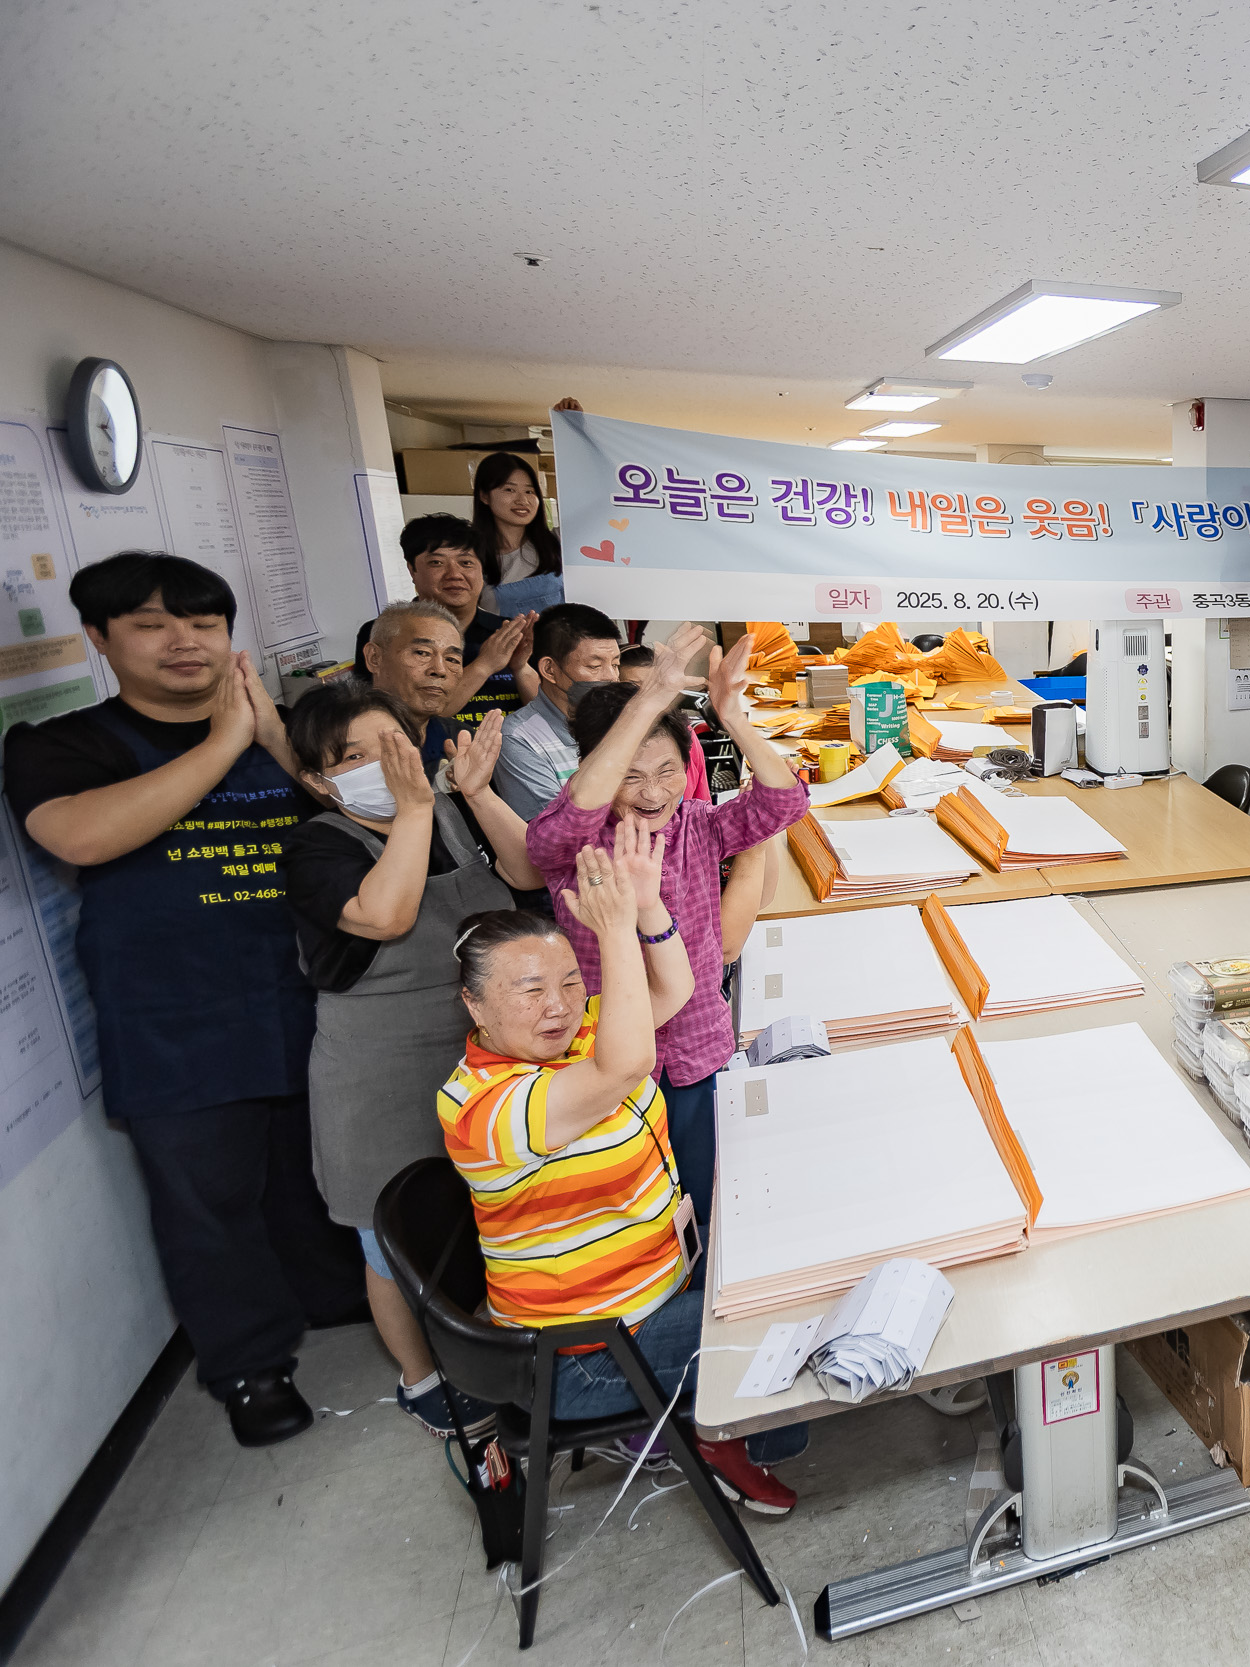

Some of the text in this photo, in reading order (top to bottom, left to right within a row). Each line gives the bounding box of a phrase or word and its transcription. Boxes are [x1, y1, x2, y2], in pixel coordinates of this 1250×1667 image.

[611, 462, 757, 522] 오늘은
[769, 477, 874, 528] 건강!
[887, 490, 1013, 538] 내일은
[1022, 499, 1113, 539] 웃음!
[827, 588, 871, 610] 일자
[896, 591, 948, 610] 2025.
[954, 592, 969, 609] 8.
[1135, 593, 1171, 610] 주관
[877, 736, 900, 745] CHESS
[169, 820, 205, 831] 쇼핑백
[167, 842, 284, 862] 넌 쇼핑백 들고 있을
[222, 861, 277, 877] 제일 예뻐
[199, 888, 286, 904] TEL. 02-468-
